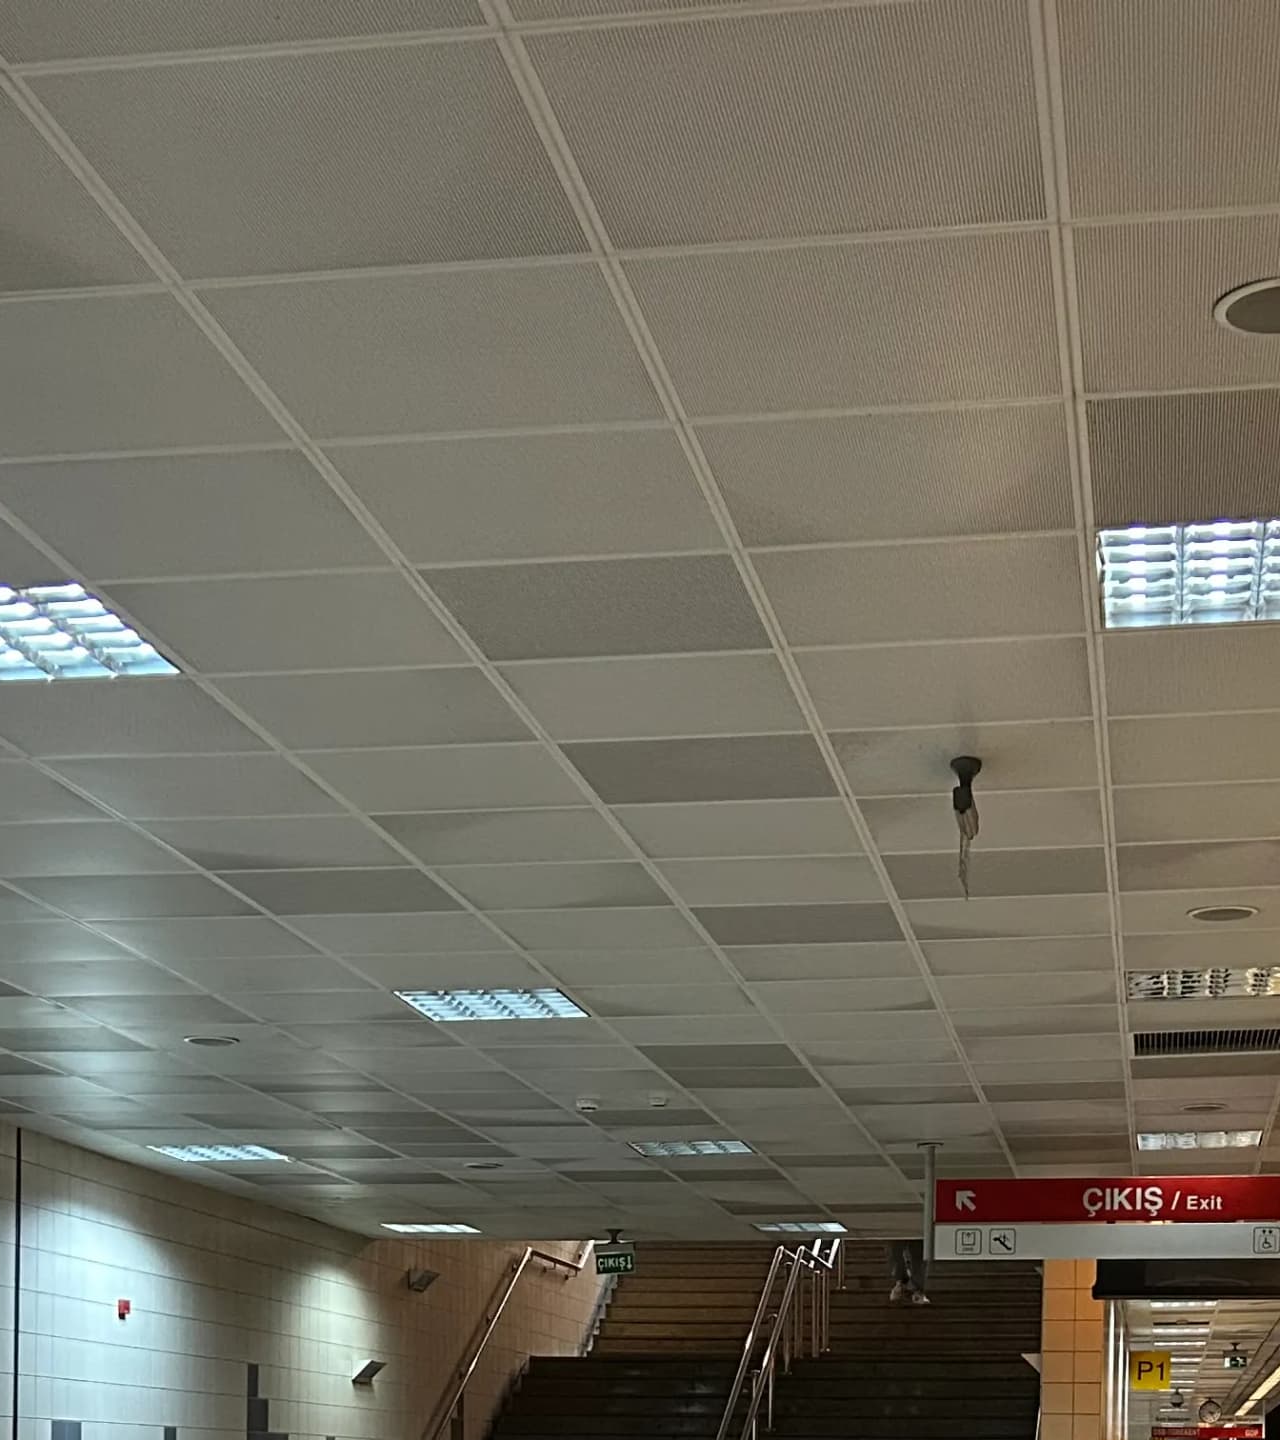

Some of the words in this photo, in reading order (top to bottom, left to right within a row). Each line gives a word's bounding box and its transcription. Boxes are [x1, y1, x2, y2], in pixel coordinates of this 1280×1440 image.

[1083, 1187, 1163, 1217] ÇIKIŞ
[1187, 1195, 1222, 1210] Exit
[1137, 1361, 1165, 1380] P1
